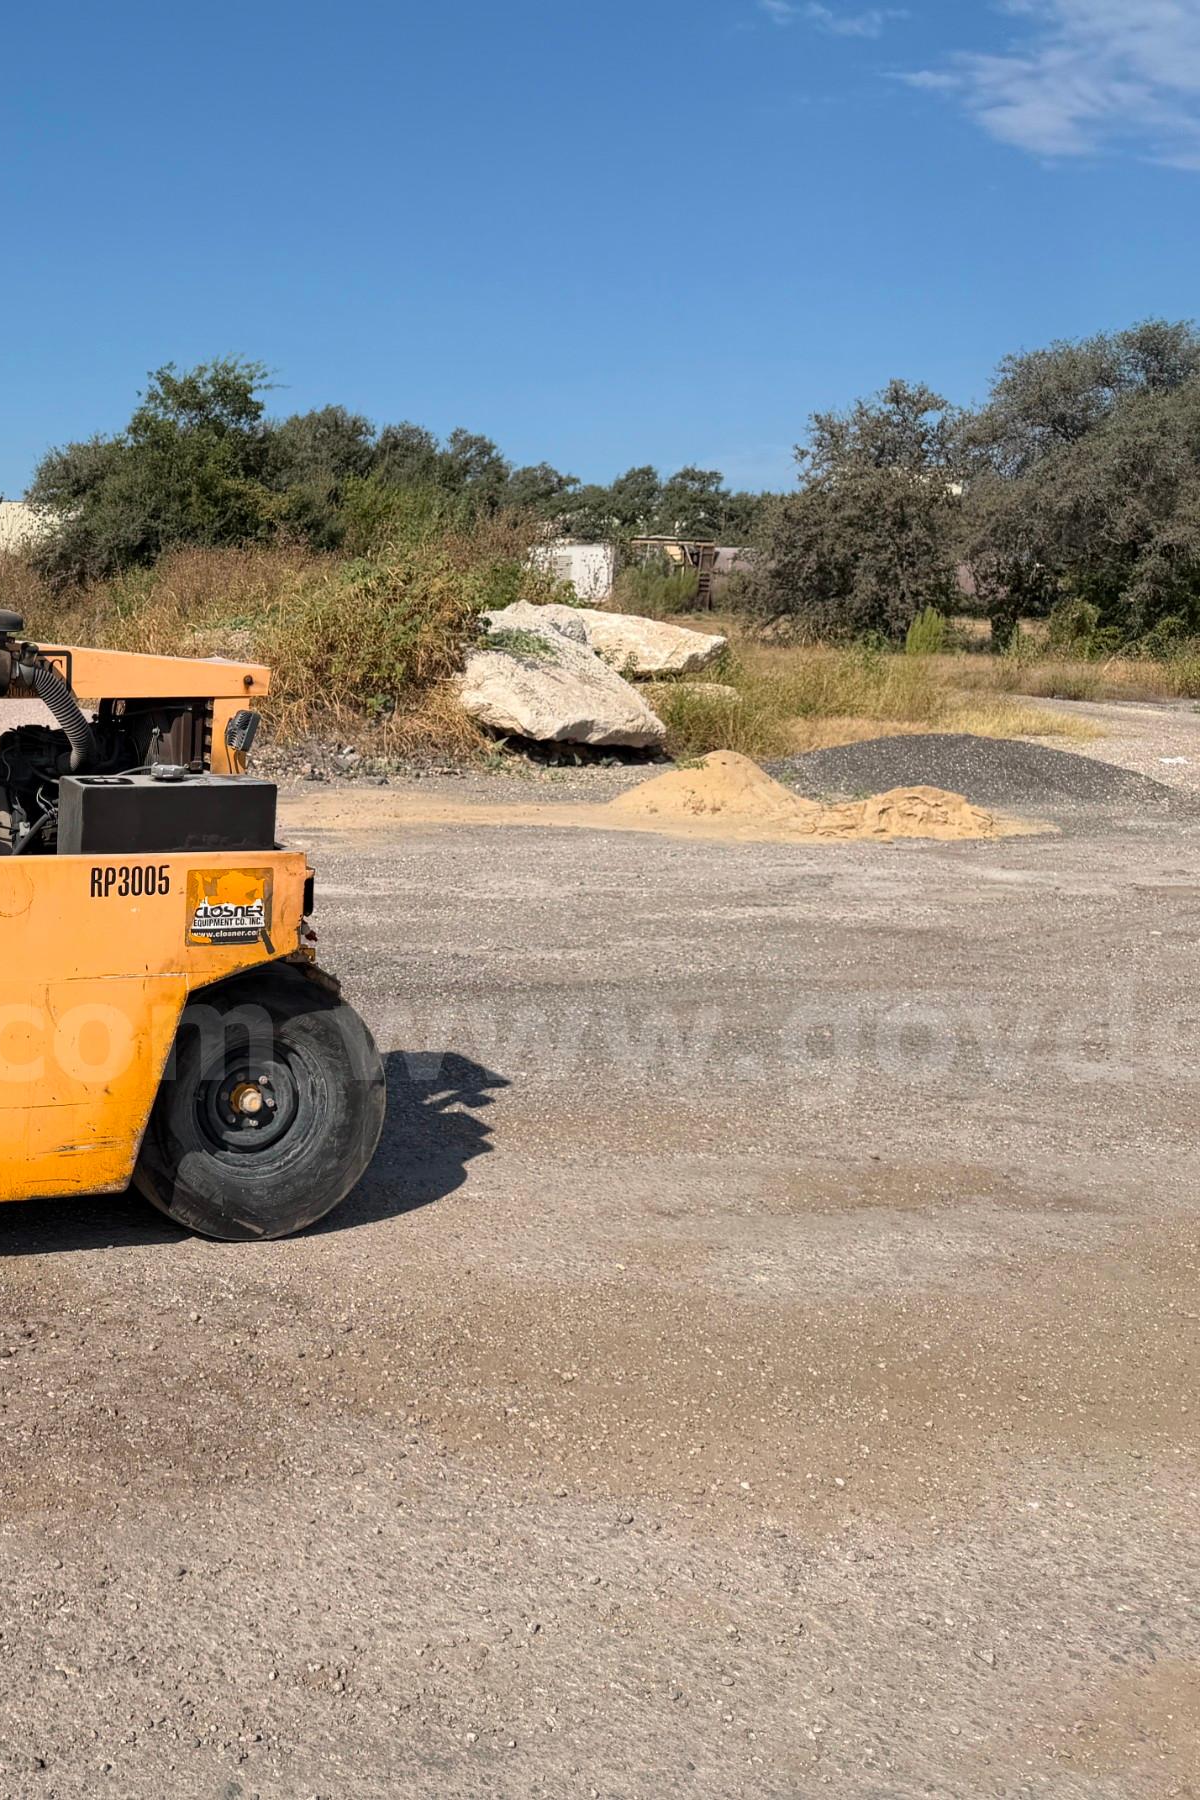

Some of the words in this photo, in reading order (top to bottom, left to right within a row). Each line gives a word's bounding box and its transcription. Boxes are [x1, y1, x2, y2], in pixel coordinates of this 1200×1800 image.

[90, 865, 170, 898] RP3005
[193, 918, 234, 927] EQUIPMENT
[235, 917, 247, 926] CO.
[249, 917, 263, 925] INC.
[191, 930, 258, 938] www.closner.co
